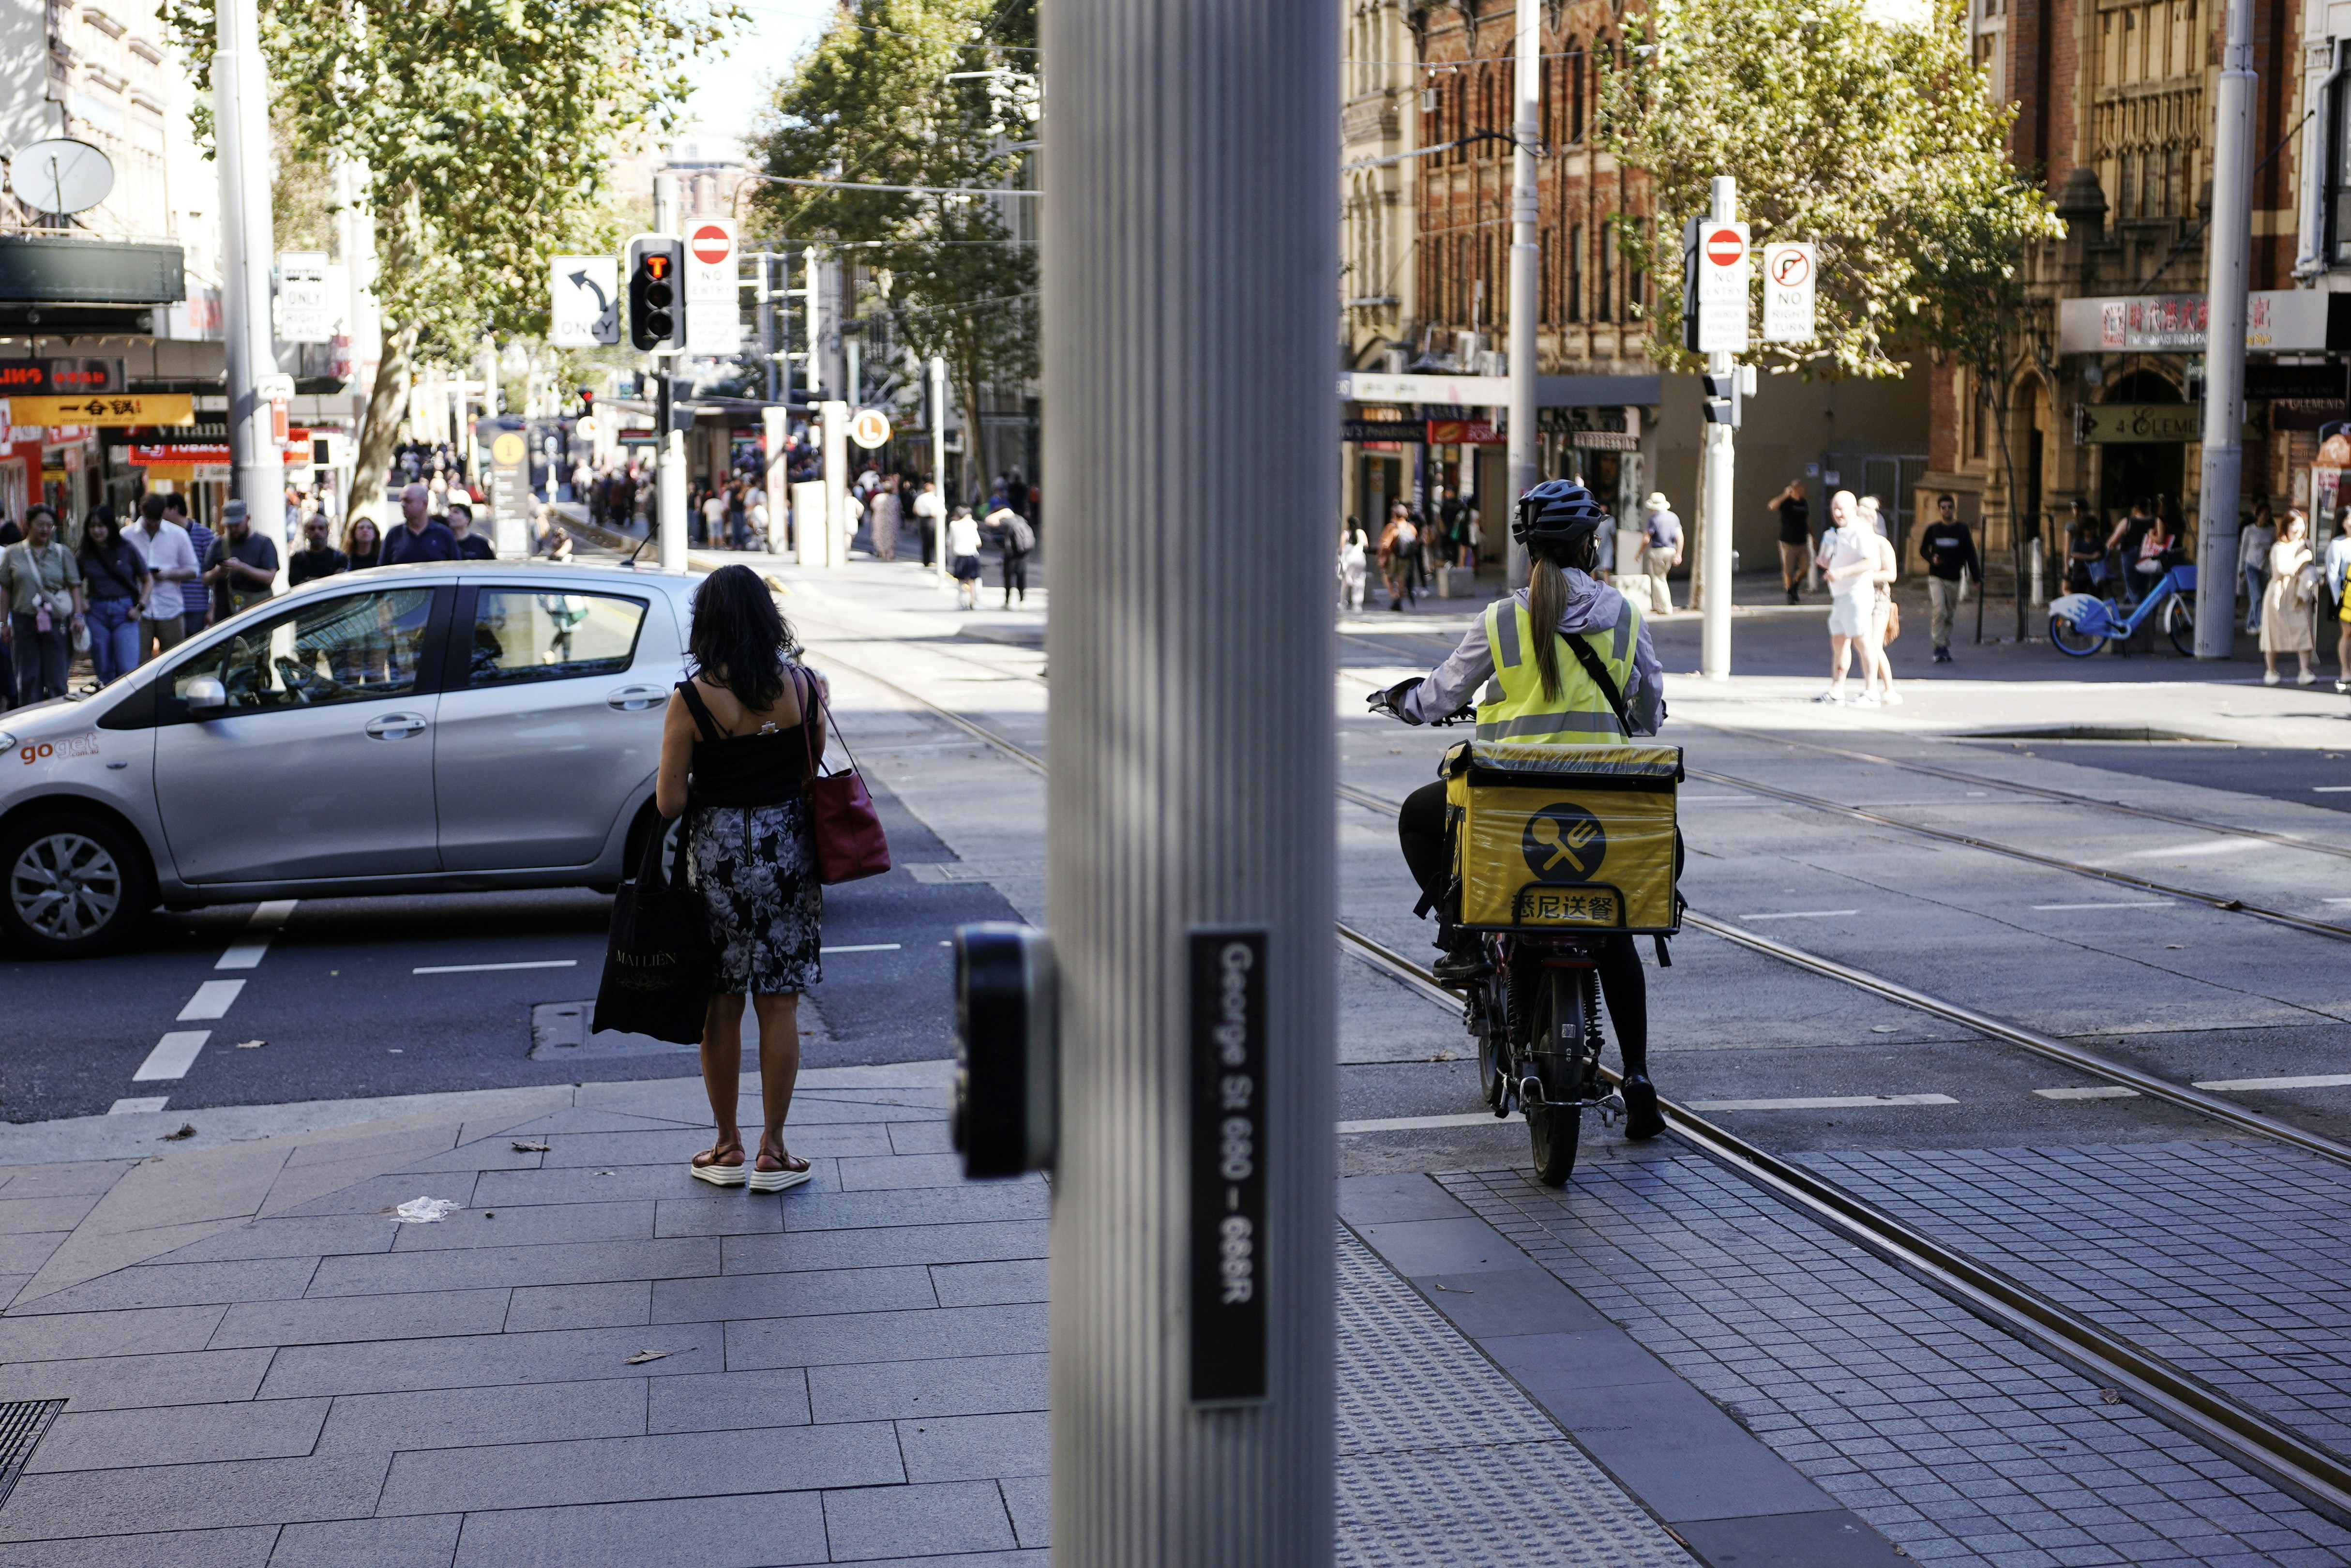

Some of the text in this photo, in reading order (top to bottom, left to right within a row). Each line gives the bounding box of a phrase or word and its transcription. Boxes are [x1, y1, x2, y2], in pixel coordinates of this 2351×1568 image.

[647, 257, 667, 278] T
[701, 271, 722, 280] NO
[1714, 271, 1734, 282] NO
[289, 290, 321, 304] ONLY
[693, 286, 731, 294] ENTRY
[1706, 287, 1742, 296] ENTRY
[1778, 292, 1802, 304] NO
[1773, 310, 1807, 318] RIGHT
[562, 320, 614, 334] ONLY
[1775, 323, 1806, 332] TURN
[863, 417, 880, 439] L
[20, 732, 98, 765] goget
[70, 749, 99, 757] .com.au
[1510, 895, 1613, 921] 悉尼送餐
[616, 949, 676, 967] MAI LIÊN
[1212, 941, 1253, 1066] George
[1221, 1074, 1253, 1110] St
